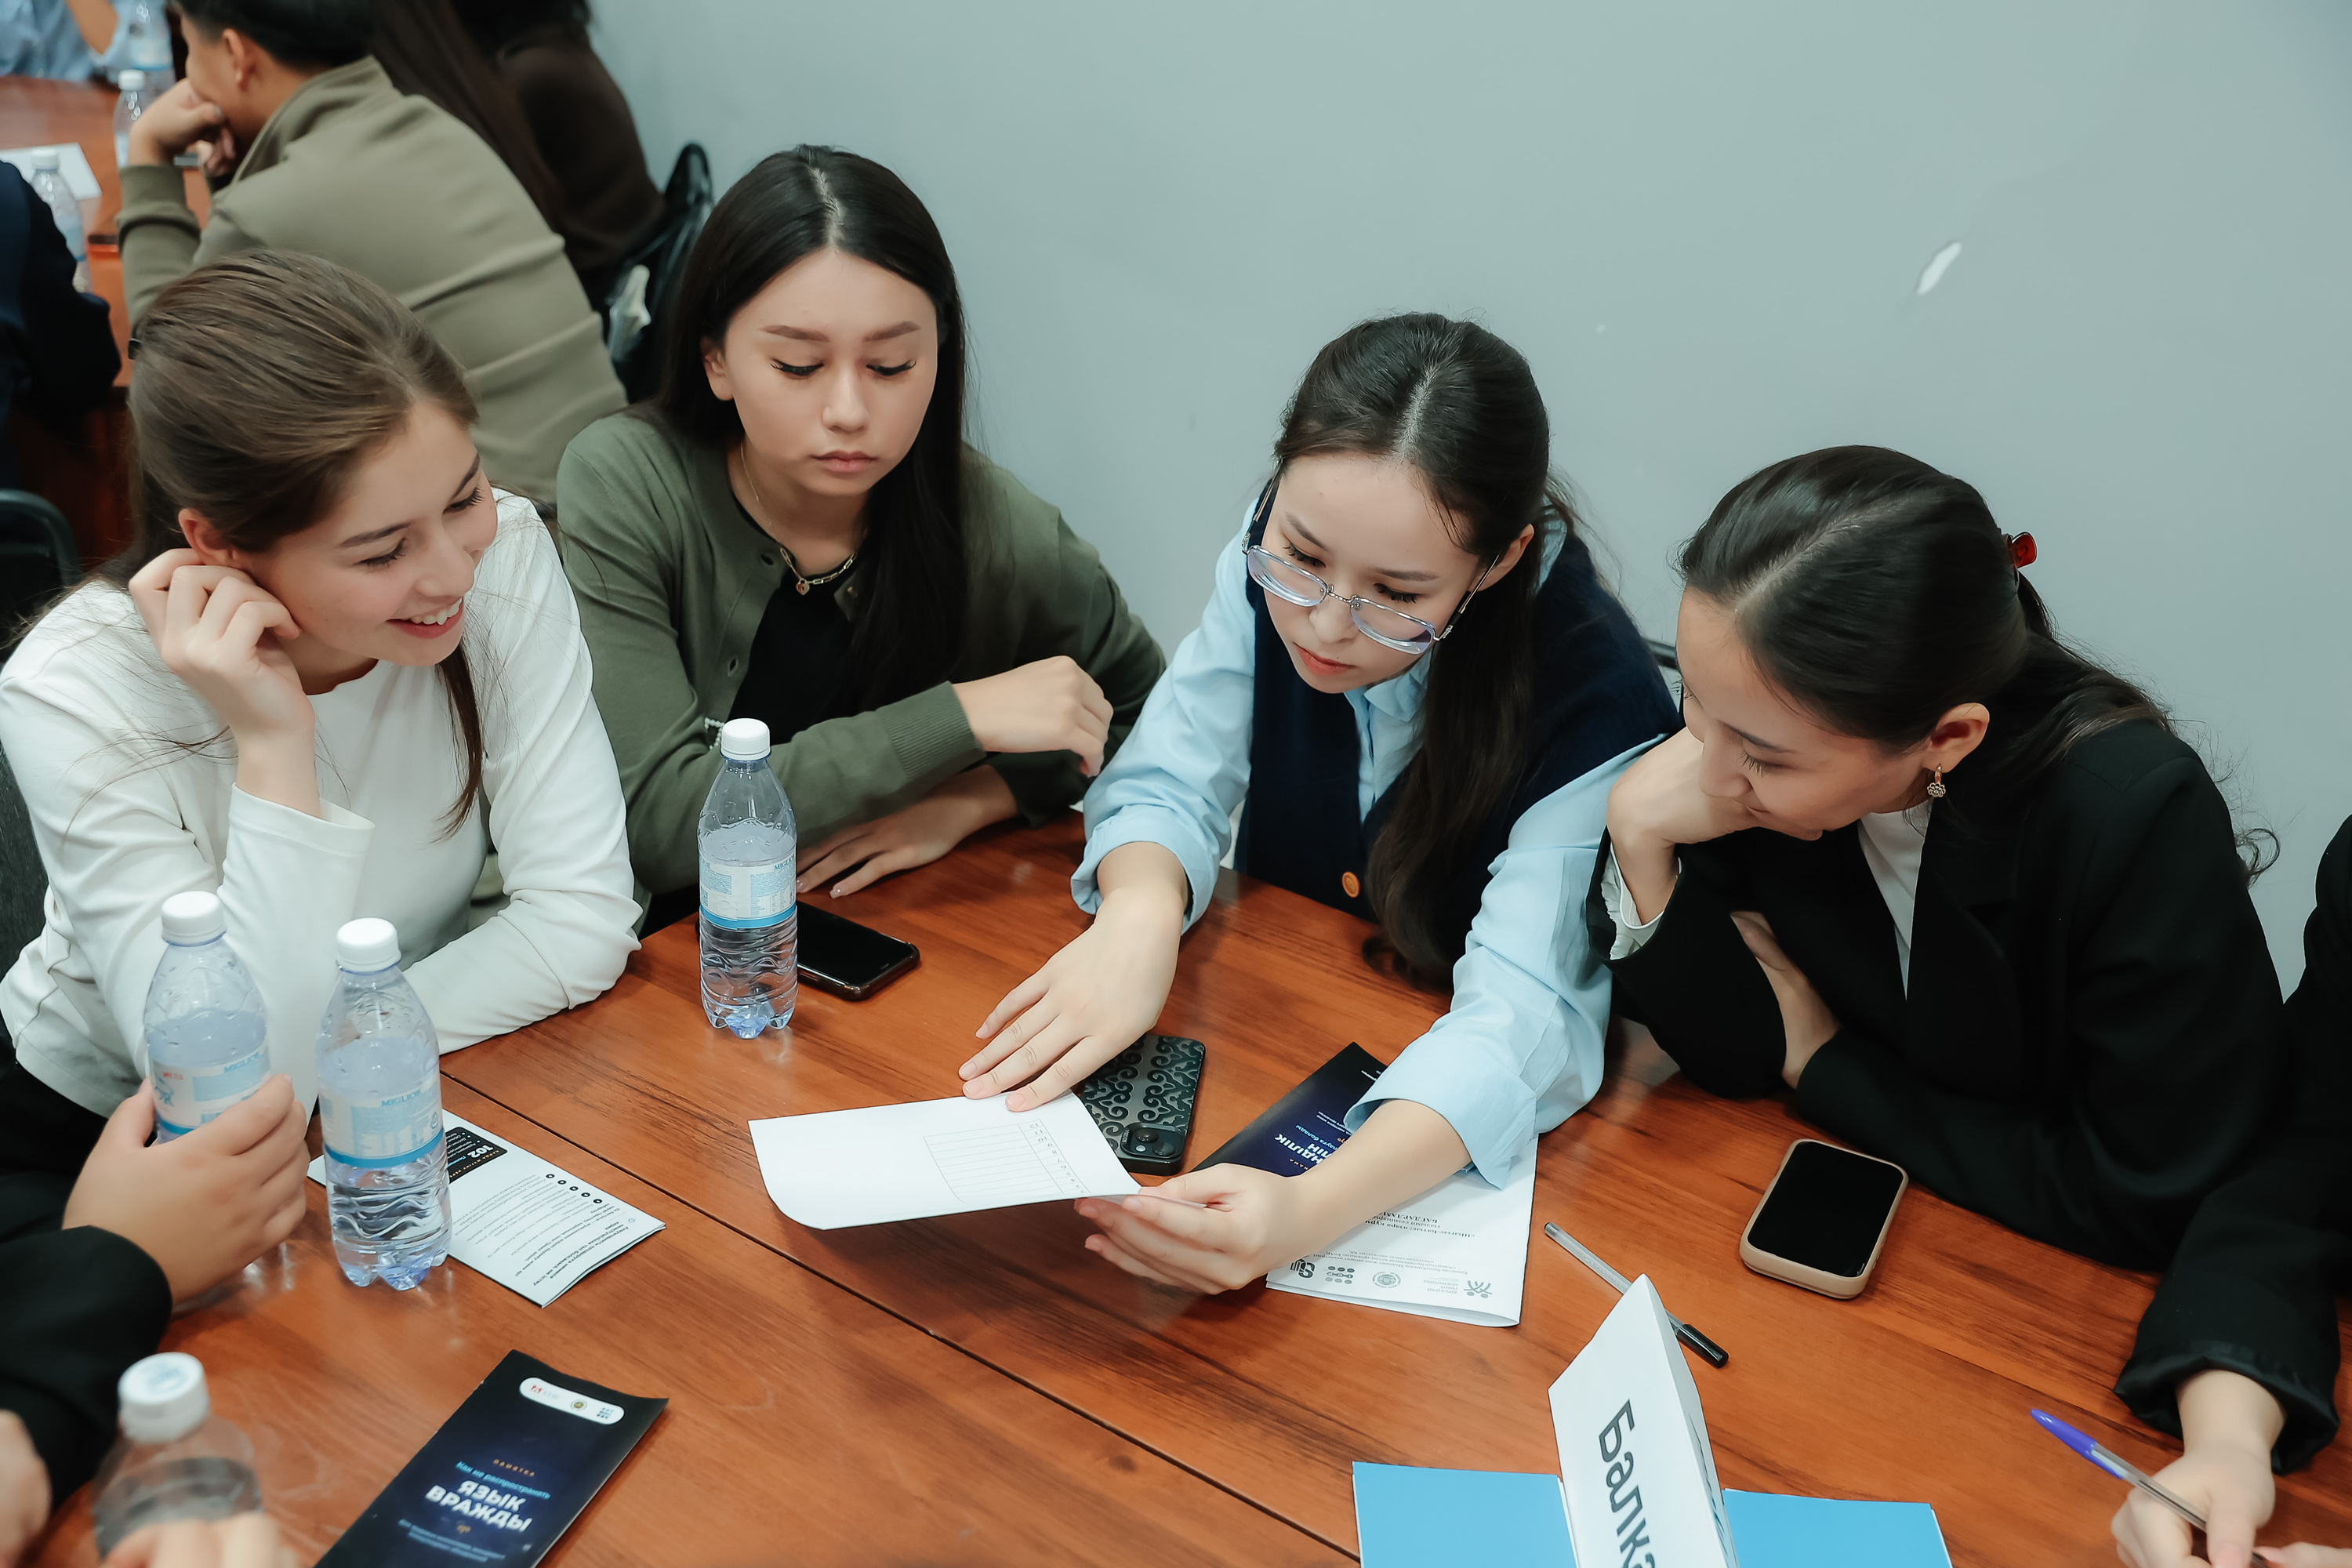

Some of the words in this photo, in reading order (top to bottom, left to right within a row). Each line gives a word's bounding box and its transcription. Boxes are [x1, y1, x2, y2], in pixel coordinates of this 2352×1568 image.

[1295, 1124, 1319, 1142] болады
[466, 1145, 494, 1158] 102
[1274, 1134, 1324, 1164] НДІЛІК
[1307, 1143, 1332, 1159] ЛІН
[1319, 1139, 1338, 1151] пауға
[1290, 1158, 1308, 1171] НАМА
[455, 1461, 473, 1474] Как
[456, 1479, 527, 1512] ЯЗЫК
[424, 1484, 533, 1534] ВРАЖДЫ
